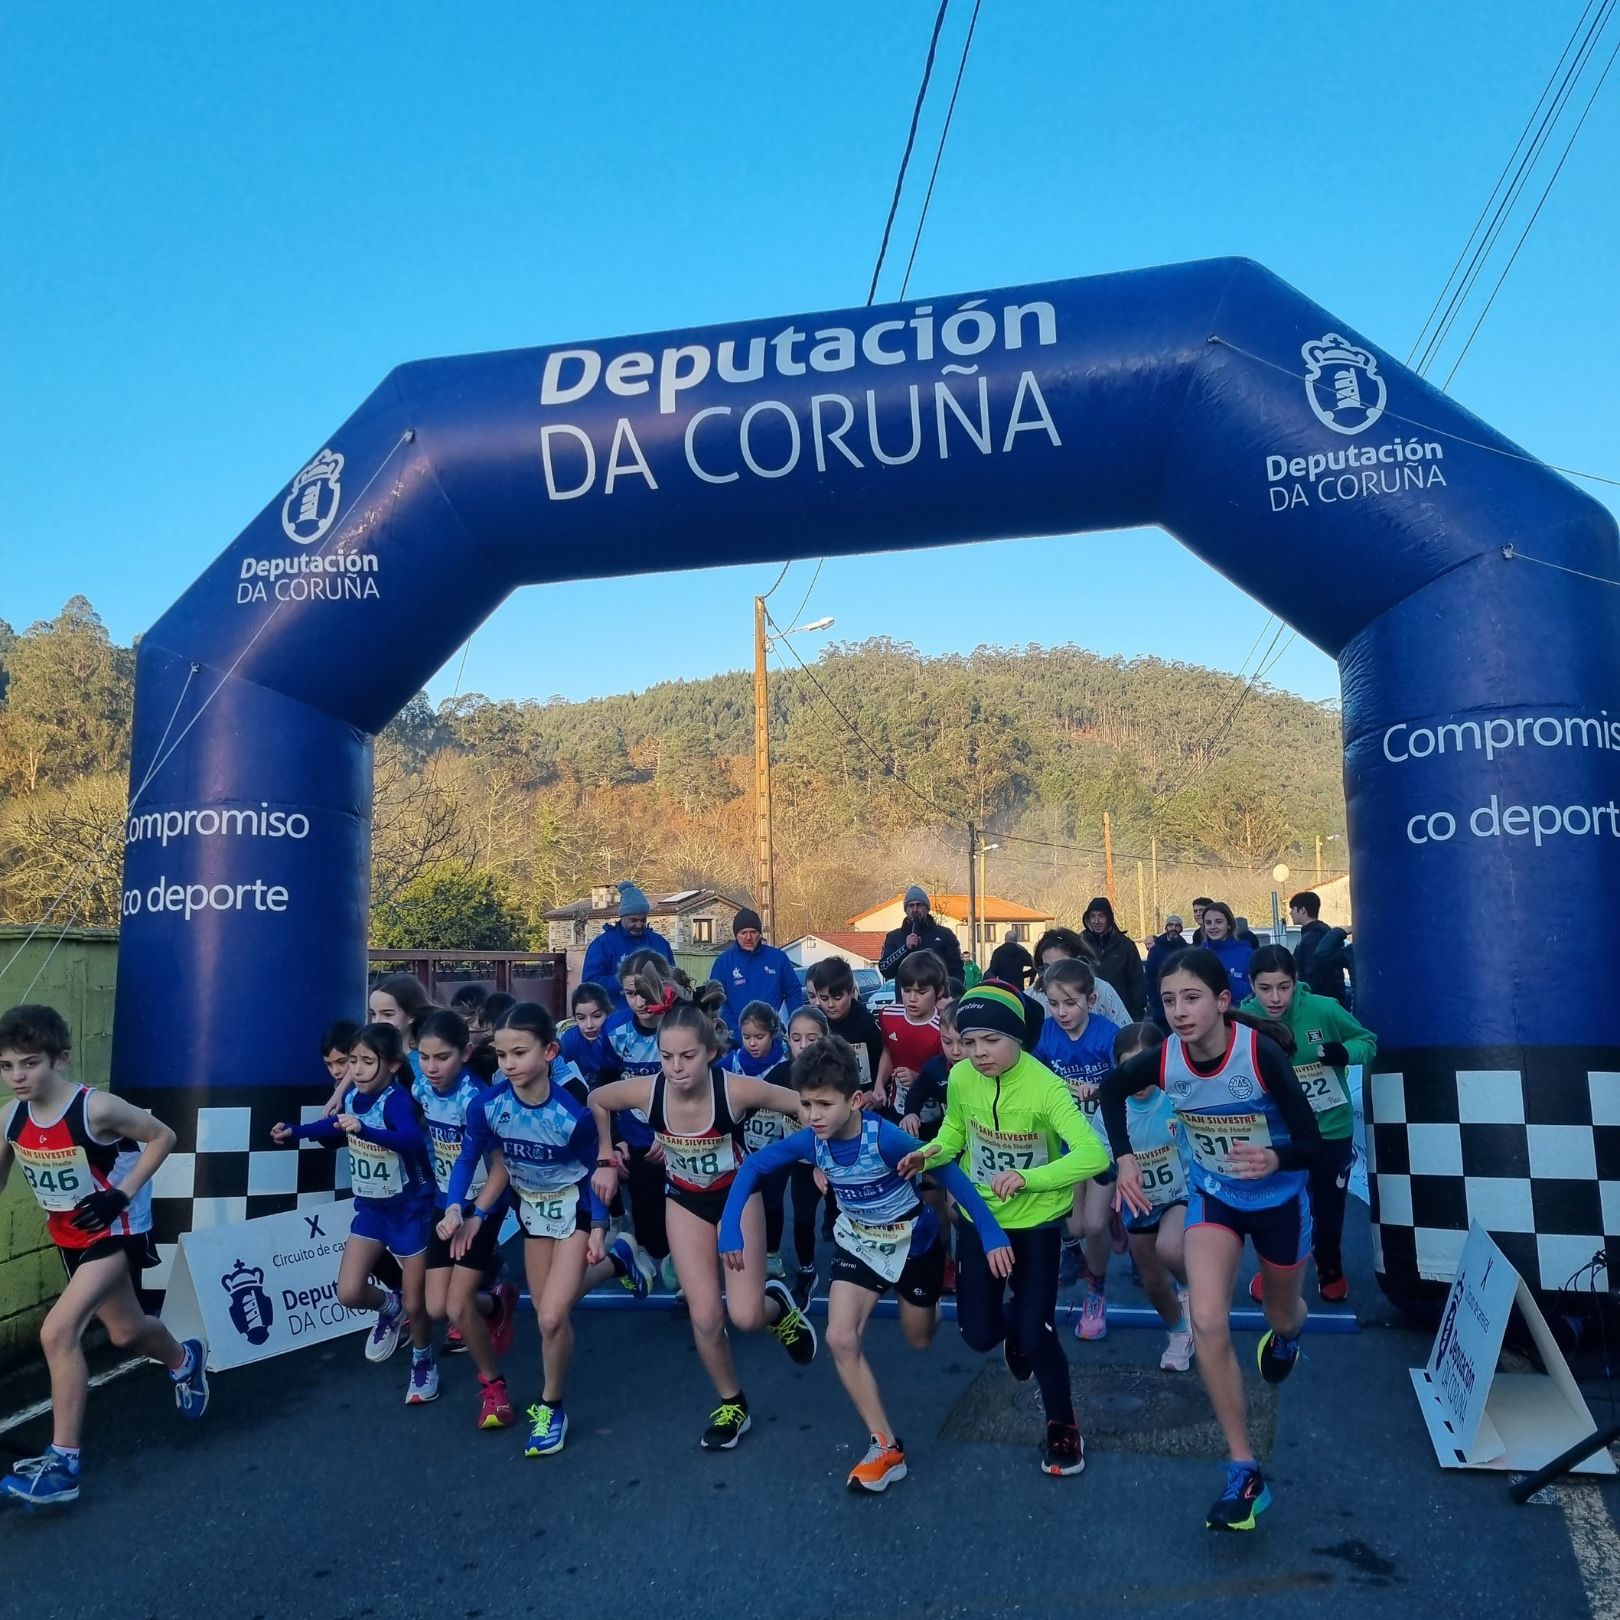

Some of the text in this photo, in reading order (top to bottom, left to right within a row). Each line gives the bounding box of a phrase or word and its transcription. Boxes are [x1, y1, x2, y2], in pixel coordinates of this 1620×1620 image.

[541, 299, 1057, 414] Deputación
[540, 364, 1062, 500] DA CORUÑA
[1266, 437, 1443, 482] Deputación
[1269, 462, 1447, 512] DA CORUÑA
[240, 549, 379, 581] Deputación
[237, 573, 380, 604] DA CORUÑA
[1407, 811, 1456, 844] co
[123, 876, 289, 920] co deporte
[1208, 1115, 1257, 1124] SILVESTRE
[995, 1132, 1039, 1141] SILVESTRE
[1195, 1133, 1250, 1156] 31
[34, 1148, 78, 1160] SILVESTRE
[981, 1145, 1034, 1171] 337
[23, 1165, 80, 1193] 346
[304, 1214, 327, 1240] X
[272, 1249, 315, 1267] Circuito
[317, 1244, 331, 1256] de
[288, 1311, 316, 1335] DA
